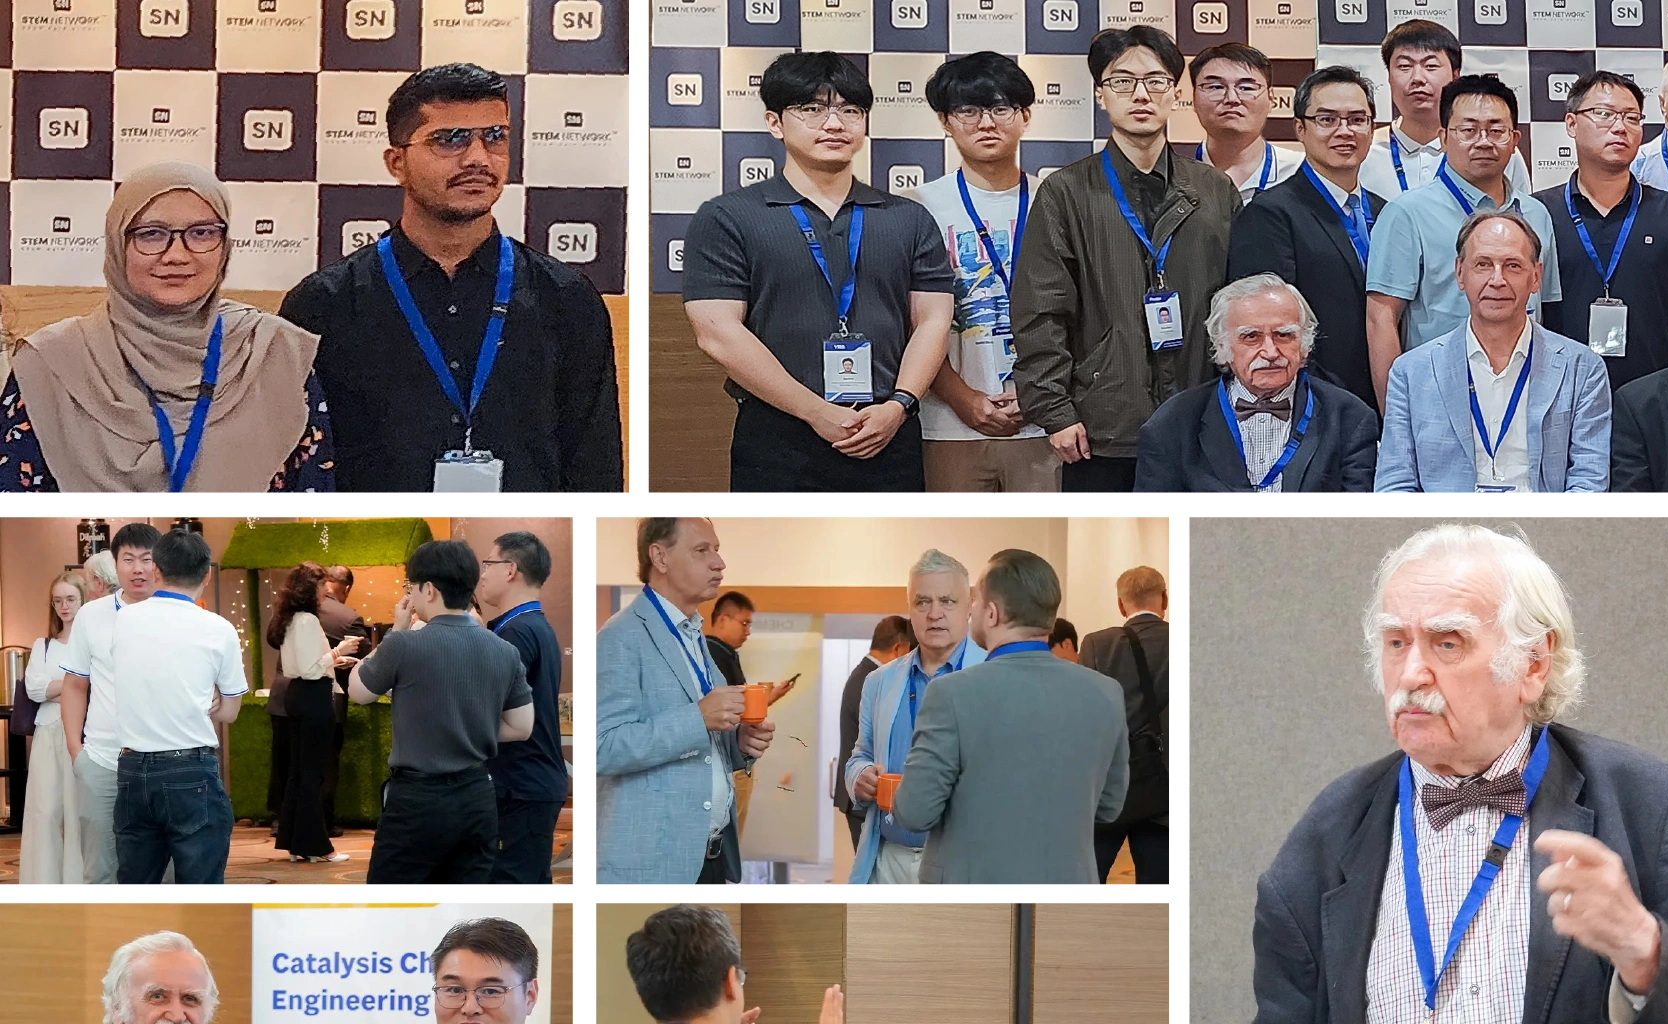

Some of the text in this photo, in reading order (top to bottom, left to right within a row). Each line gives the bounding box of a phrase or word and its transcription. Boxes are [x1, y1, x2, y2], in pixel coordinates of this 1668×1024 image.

[149, 9, 180, 25] SN
[898, 6, 921, 19] SN
[1050, 9, 1072, 22] SN
[1130, 15, 1167, 23] NETWORK
[1617, 7, 1637, 18] SN
[563, 11, 593, 29] SN
[674, 84, 696, 96] SN
[48, 120, 79, 137] SN
[121, 127, 199, 138] STEM NETWORK
[252, 122, 283, 139] SN
[895, 175, 918, 188] SN
[272, 951, 393, 979] Catalysis
[272, 989, 431, 1017] Engineering
